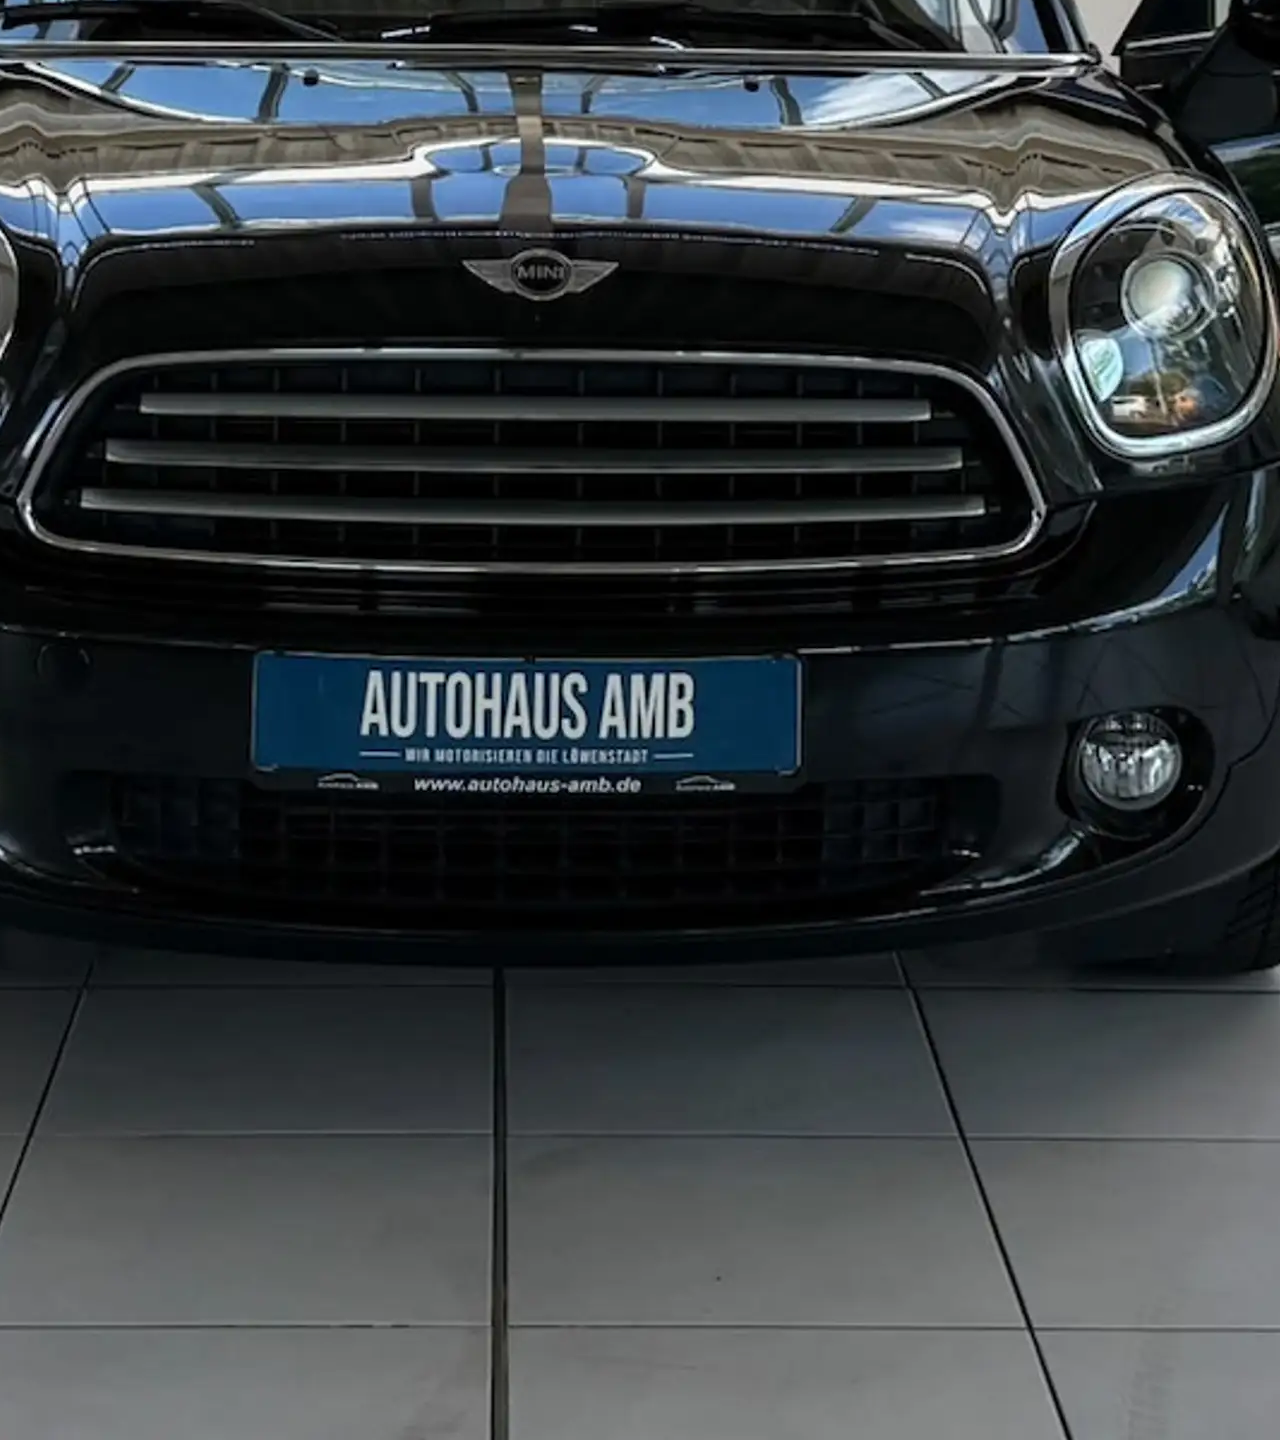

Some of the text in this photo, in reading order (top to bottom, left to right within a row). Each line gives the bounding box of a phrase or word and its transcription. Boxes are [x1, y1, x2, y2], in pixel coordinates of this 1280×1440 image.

[518, 264, 565, 280] MINI
[359, 669, 696, 740] AUTOHAUS AMB
[404, 746, 649, 766] WIR MOTORISIEREN DIE LÖWENSTADT
[413, 774, 642, 794] www.autohaus-amb.de
